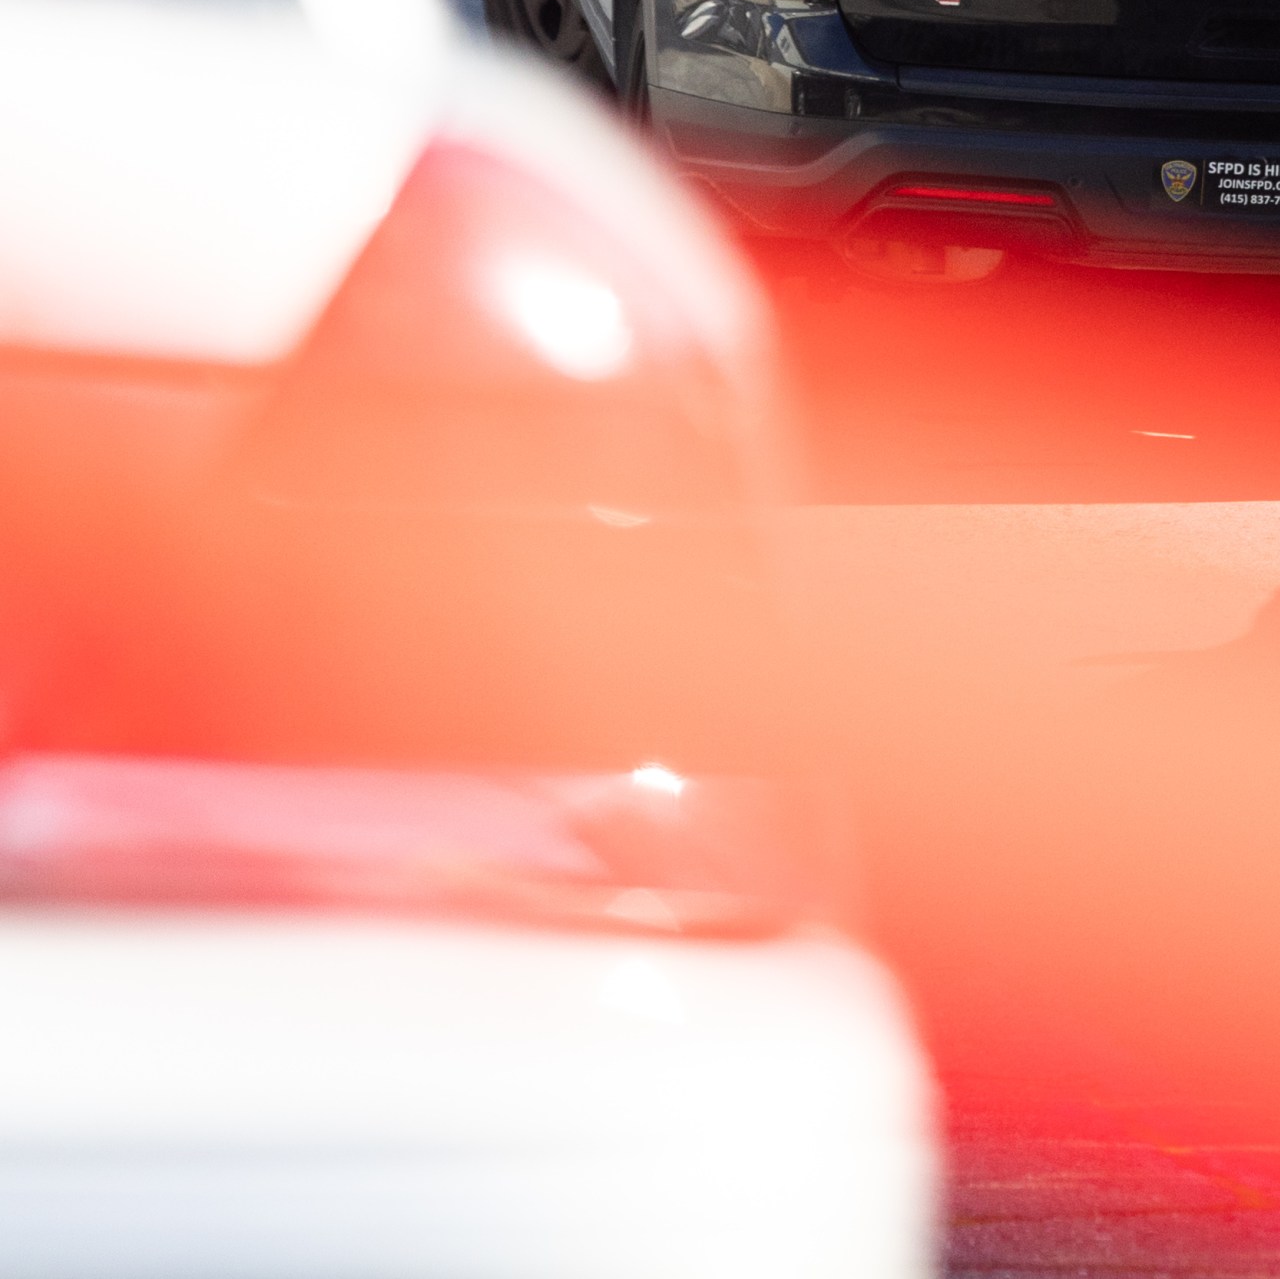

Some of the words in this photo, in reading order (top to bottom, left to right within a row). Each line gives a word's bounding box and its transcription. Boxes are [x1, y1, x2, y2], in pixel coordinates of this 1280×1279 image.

[1208, 162, 1245, 175] SFPD
[1248, 164, 1261, 176] IS
[1220, 193, 1248, 206] (415)
